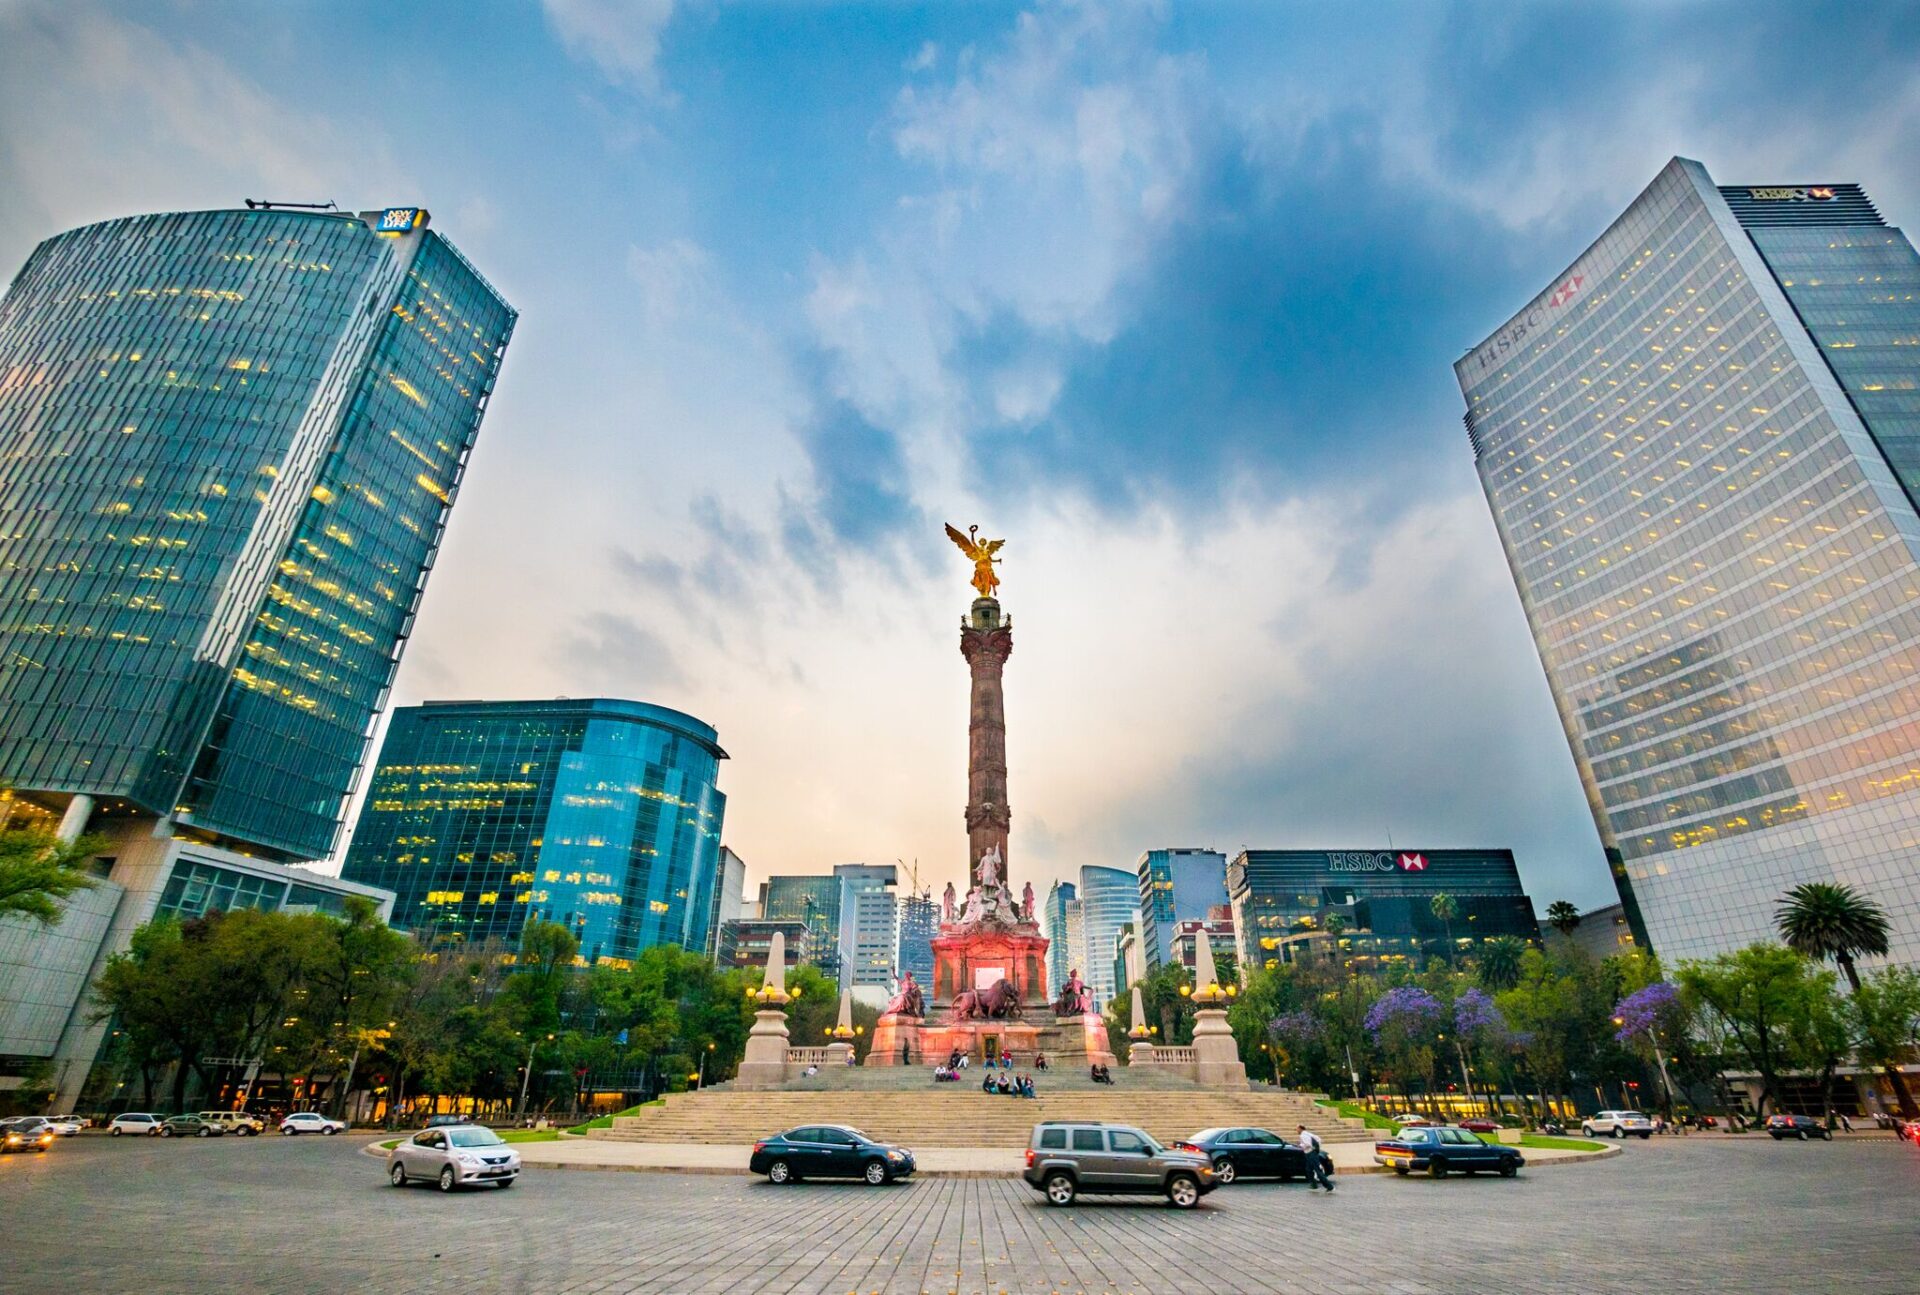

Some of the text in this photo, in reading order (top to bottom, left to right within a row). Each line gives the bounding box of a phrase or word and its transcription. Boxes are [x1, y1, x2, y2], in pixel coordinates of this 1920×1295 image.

[1749, 188, 1808, 200] HSBC
[383, 215, 412, 223] YORK
[1478, 307, 1544, 369] HSBC
[1327, 852, 1394, 871] HSBC
